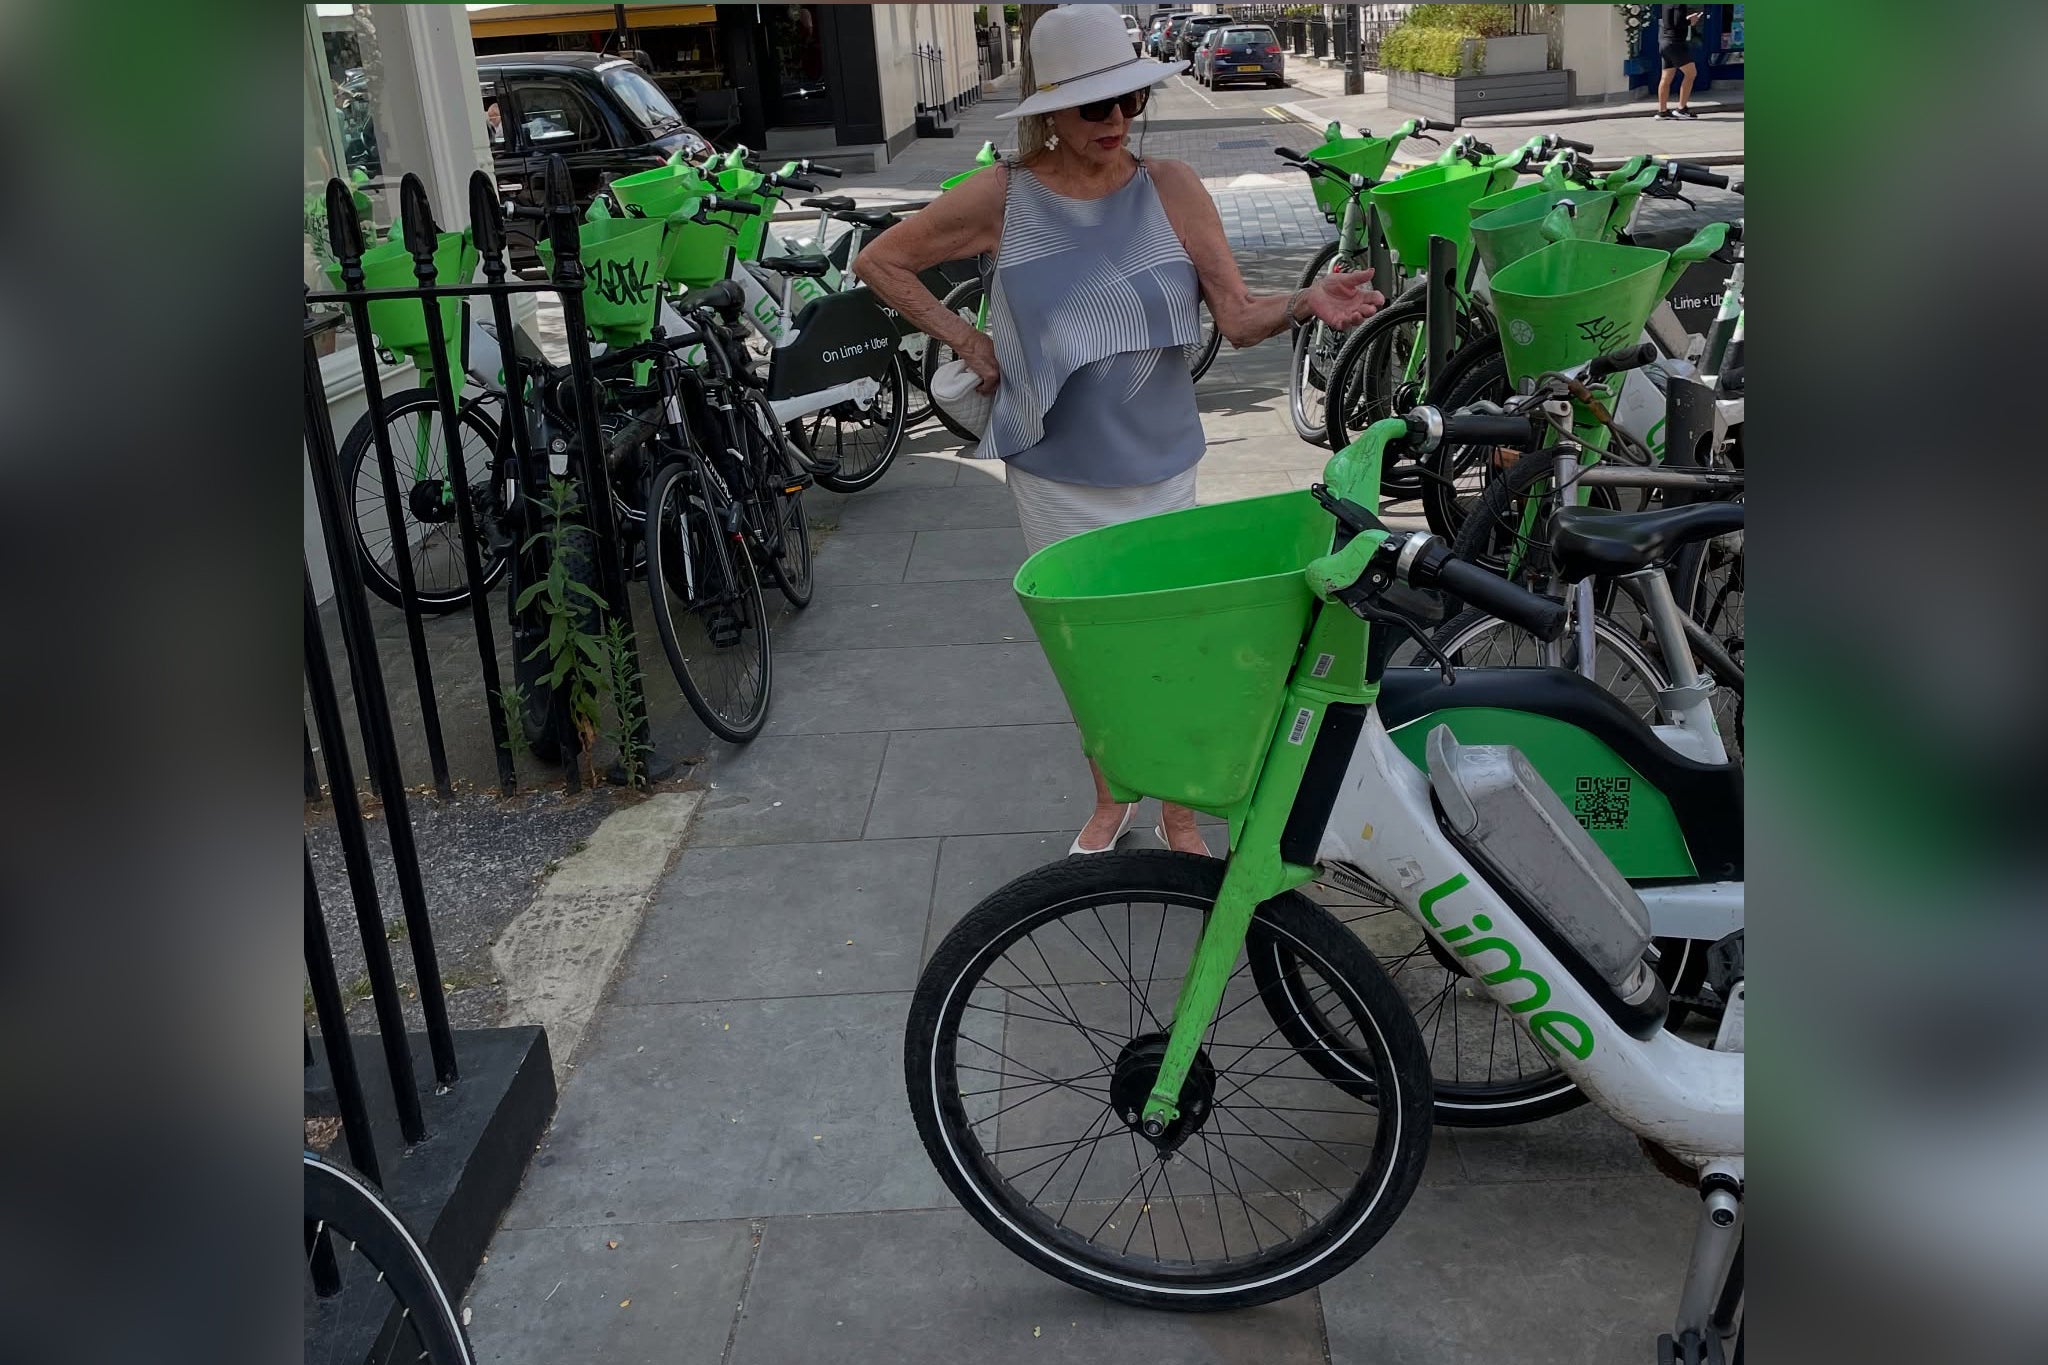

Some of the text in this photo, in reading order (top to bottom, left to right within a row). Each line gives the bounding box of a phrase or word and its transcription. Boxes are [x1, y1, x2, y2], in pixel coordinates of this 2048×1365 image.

[1673, 296, 1701, 310] Lime
[1702, 297, 1709, 305] +
[1710, 293, 1724, 307] Ub
[822, 337, 889, 363] On Lime + Uber
[1418, 872, 1595, 1061] Lime
